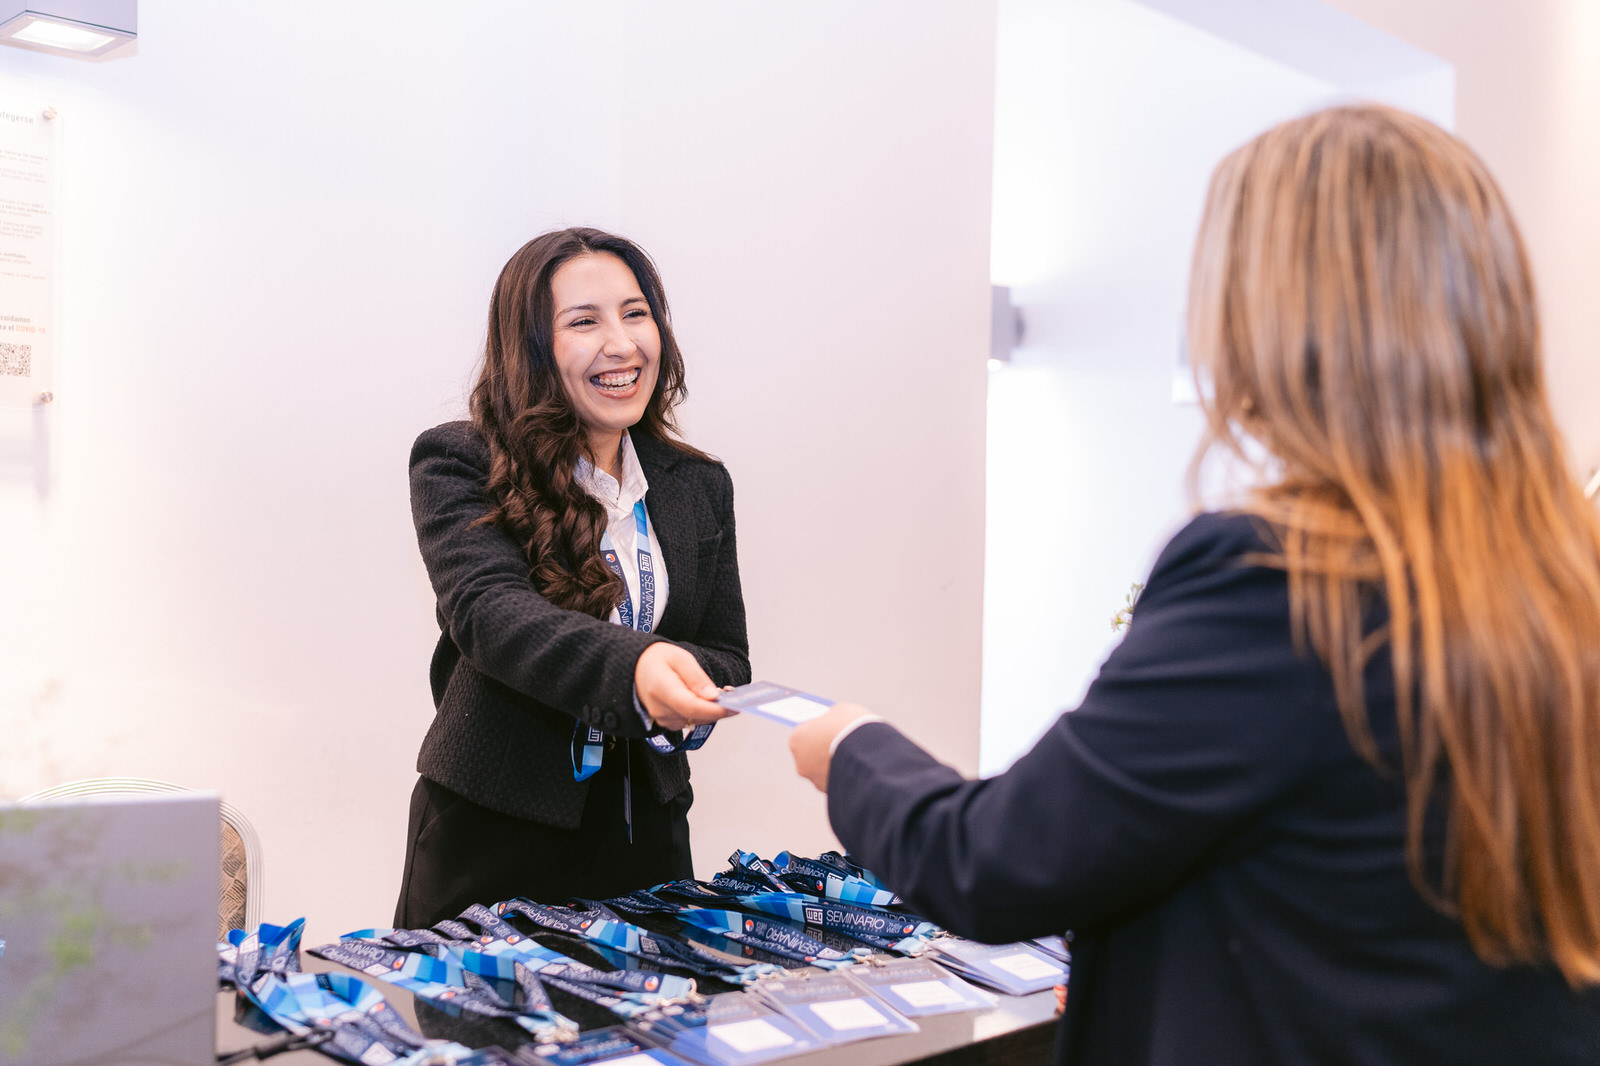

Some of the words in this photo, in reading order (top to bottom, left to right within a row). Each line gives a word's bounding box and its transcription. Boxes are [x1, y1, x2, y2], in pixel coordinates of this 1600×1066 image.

[642, 574, 654, 633] SEMINARIO
[826, 909, 885, 931] SEMINARIO
[765, 927, 819, 955] SEMINARIO
